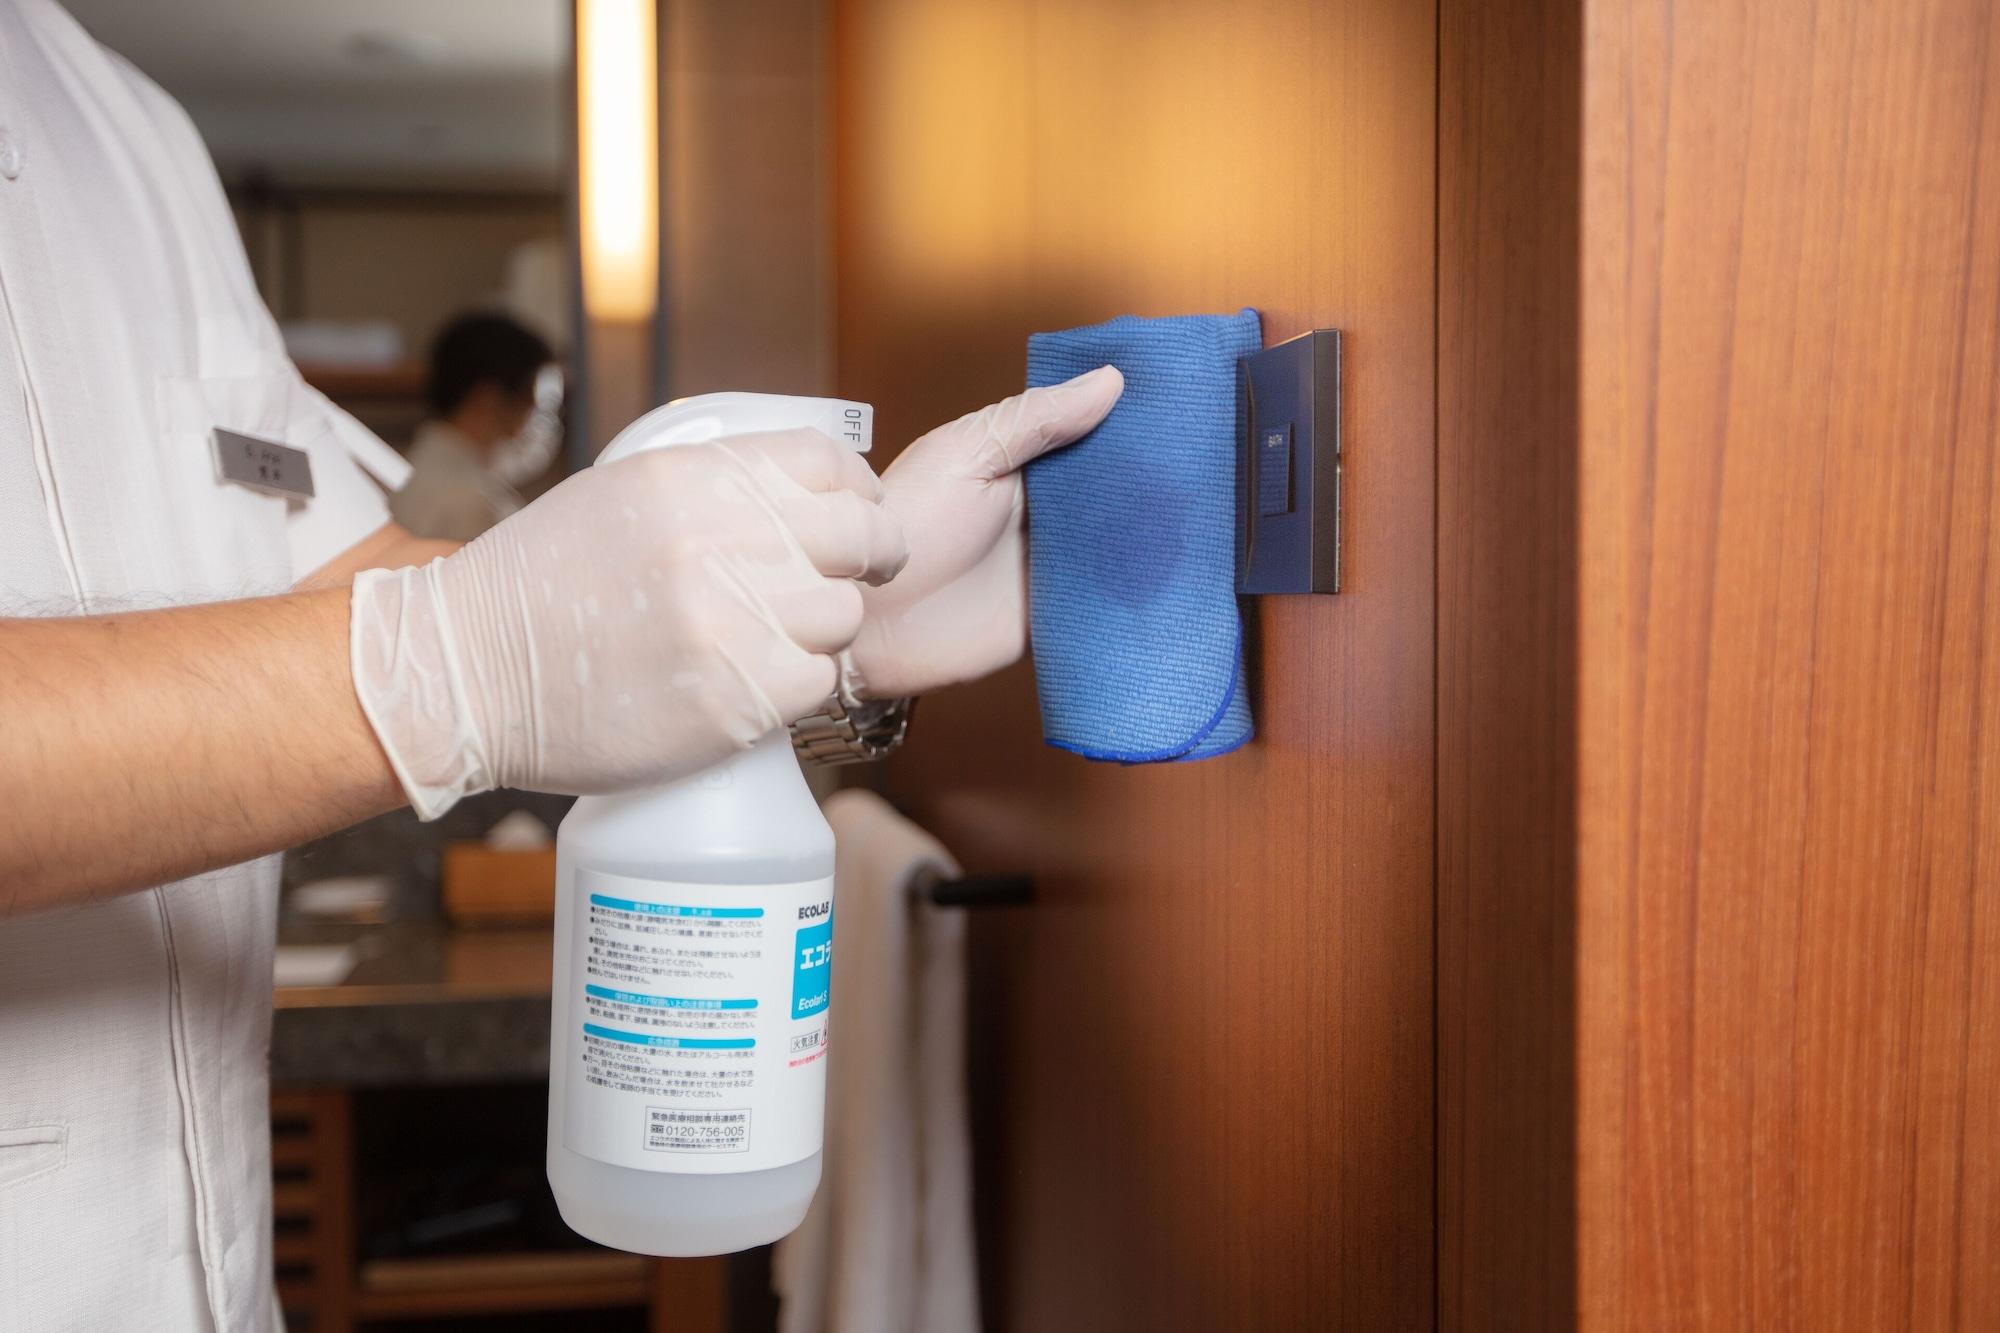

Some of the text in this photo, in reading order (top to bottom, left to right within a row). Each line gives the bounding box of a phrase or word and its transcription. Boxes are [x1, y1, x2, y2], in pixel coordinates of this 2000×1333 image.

[844, 408, 861, 443] OFF
[798, 901, 829, 919] ECOLAB
[793, 1033, 819, 1050] 火気注意
[666, 1125, 744, 1137] 0120-756-005
